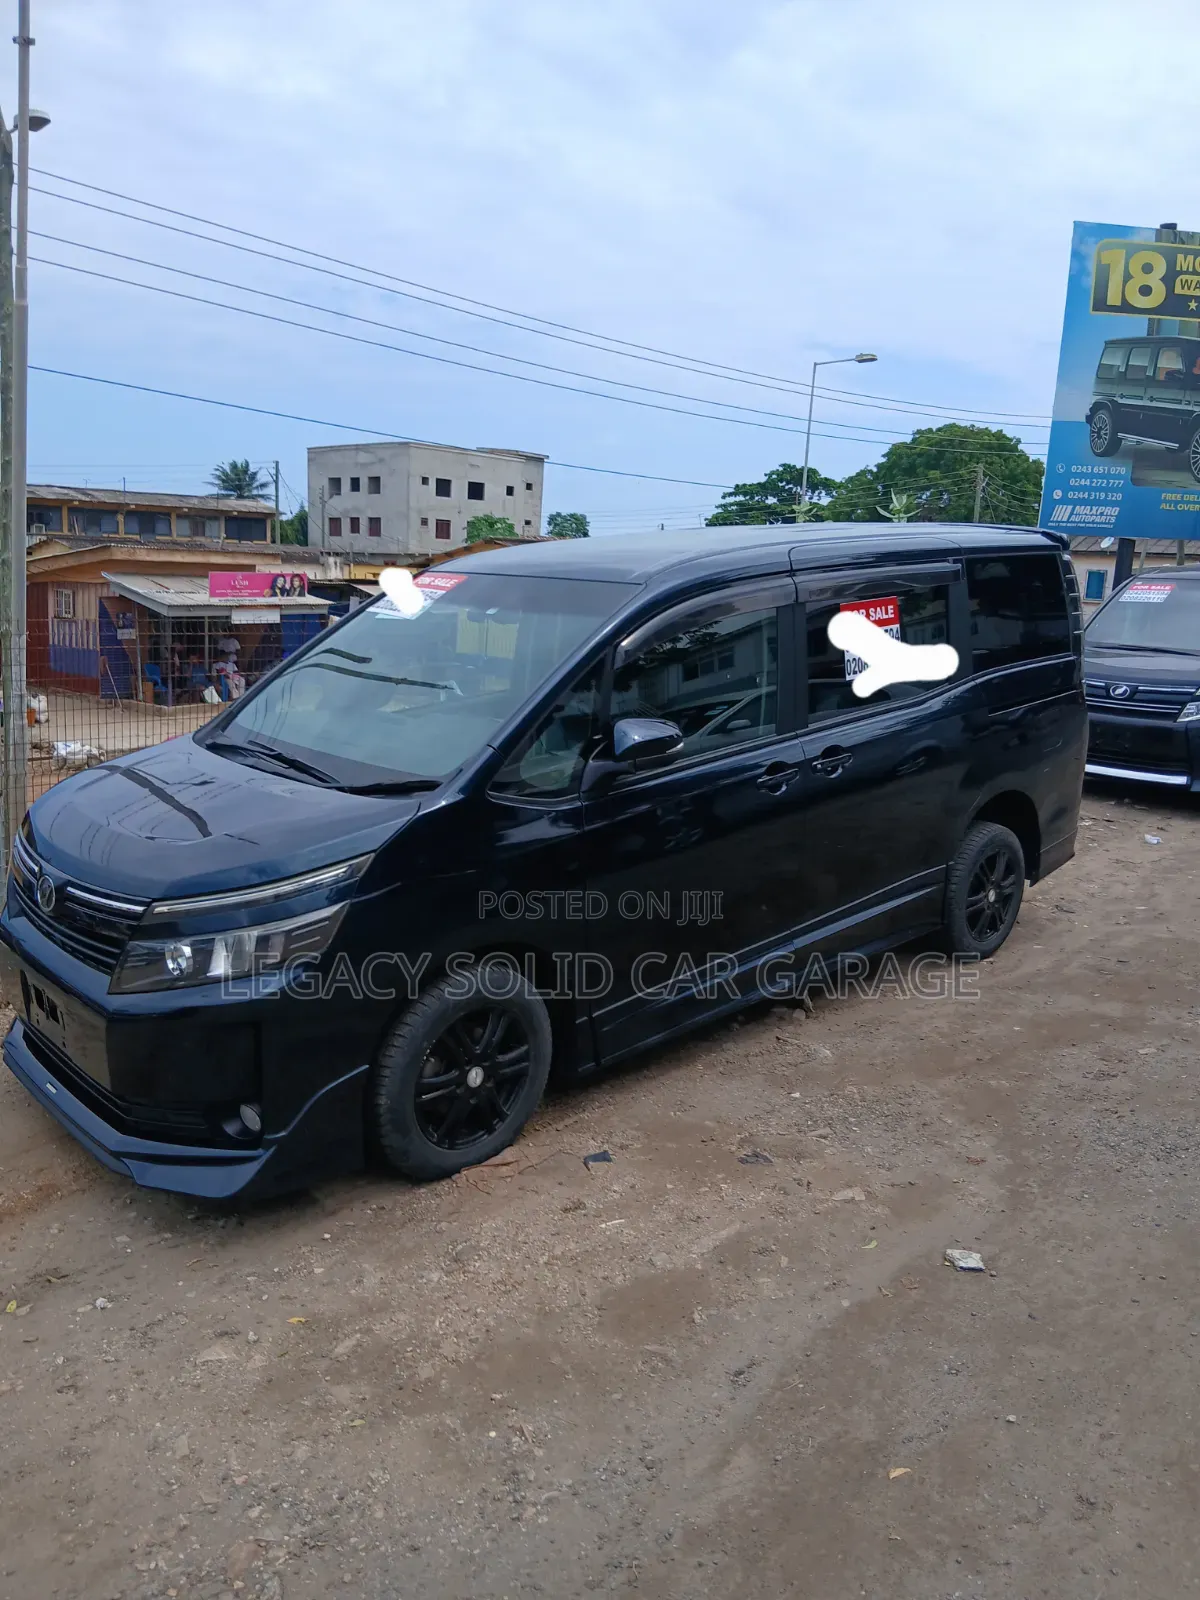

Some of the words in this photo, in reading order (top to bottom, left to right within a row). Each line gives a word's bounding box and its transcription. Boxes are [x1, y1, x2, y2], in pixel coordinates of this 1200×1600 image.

[1101, 249, 1167, 309] 18
[1071, 465, 1092, 473] 0243
[1093, 466, 1108, 474] 651
[1110, 467, 1126, 475] 070
[1069, 478, 1090, 486] 0244
[1092, 479, 1107, 487] 272
[1109, 480, 1124, 488] 777
[1068, 491, 1089, 499] 0244
[1090, 492, 1106, 500] 319
[1107, 493, 1122, 501] 320
[1161, 493, 1182, 501] FREE
[1073, 505, 1120, 516] MAXPRO
[1160, 502, 1176, 510] ALL
[1069, 515, 1116, 523] AUTOPARTS
[430, 577, 459, 588] SALE
[870, 605, 894, 621] SALE
